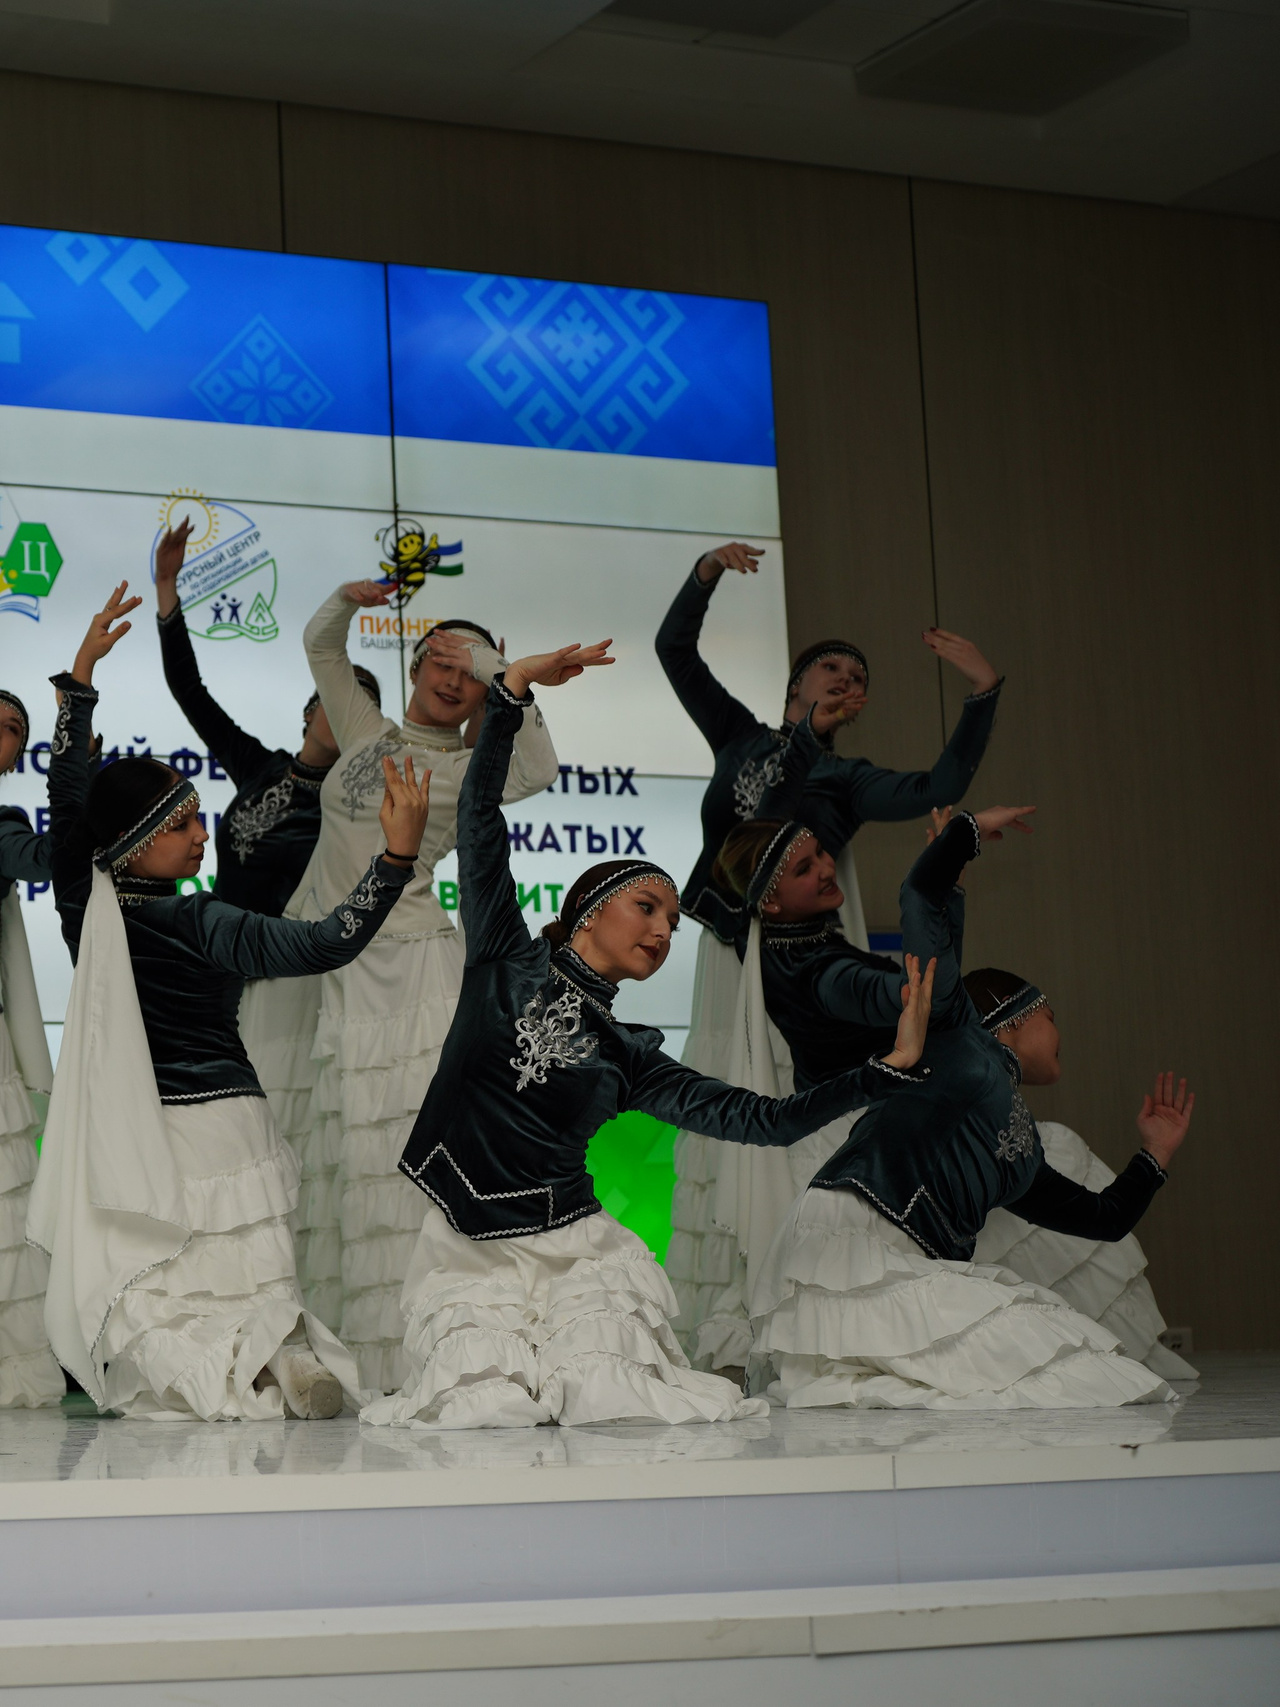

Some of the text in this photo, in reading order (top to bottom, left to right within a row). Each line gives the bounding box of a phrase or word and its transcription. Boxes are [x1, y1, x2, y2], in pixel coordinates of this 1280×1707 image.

[176, 531, 261, 588] СУРСНЫЙ ЦЕНТР
[360, 615, 444, 637] ПИОНЕ
[507, 822, 646, 855] ЖАТЫХ
